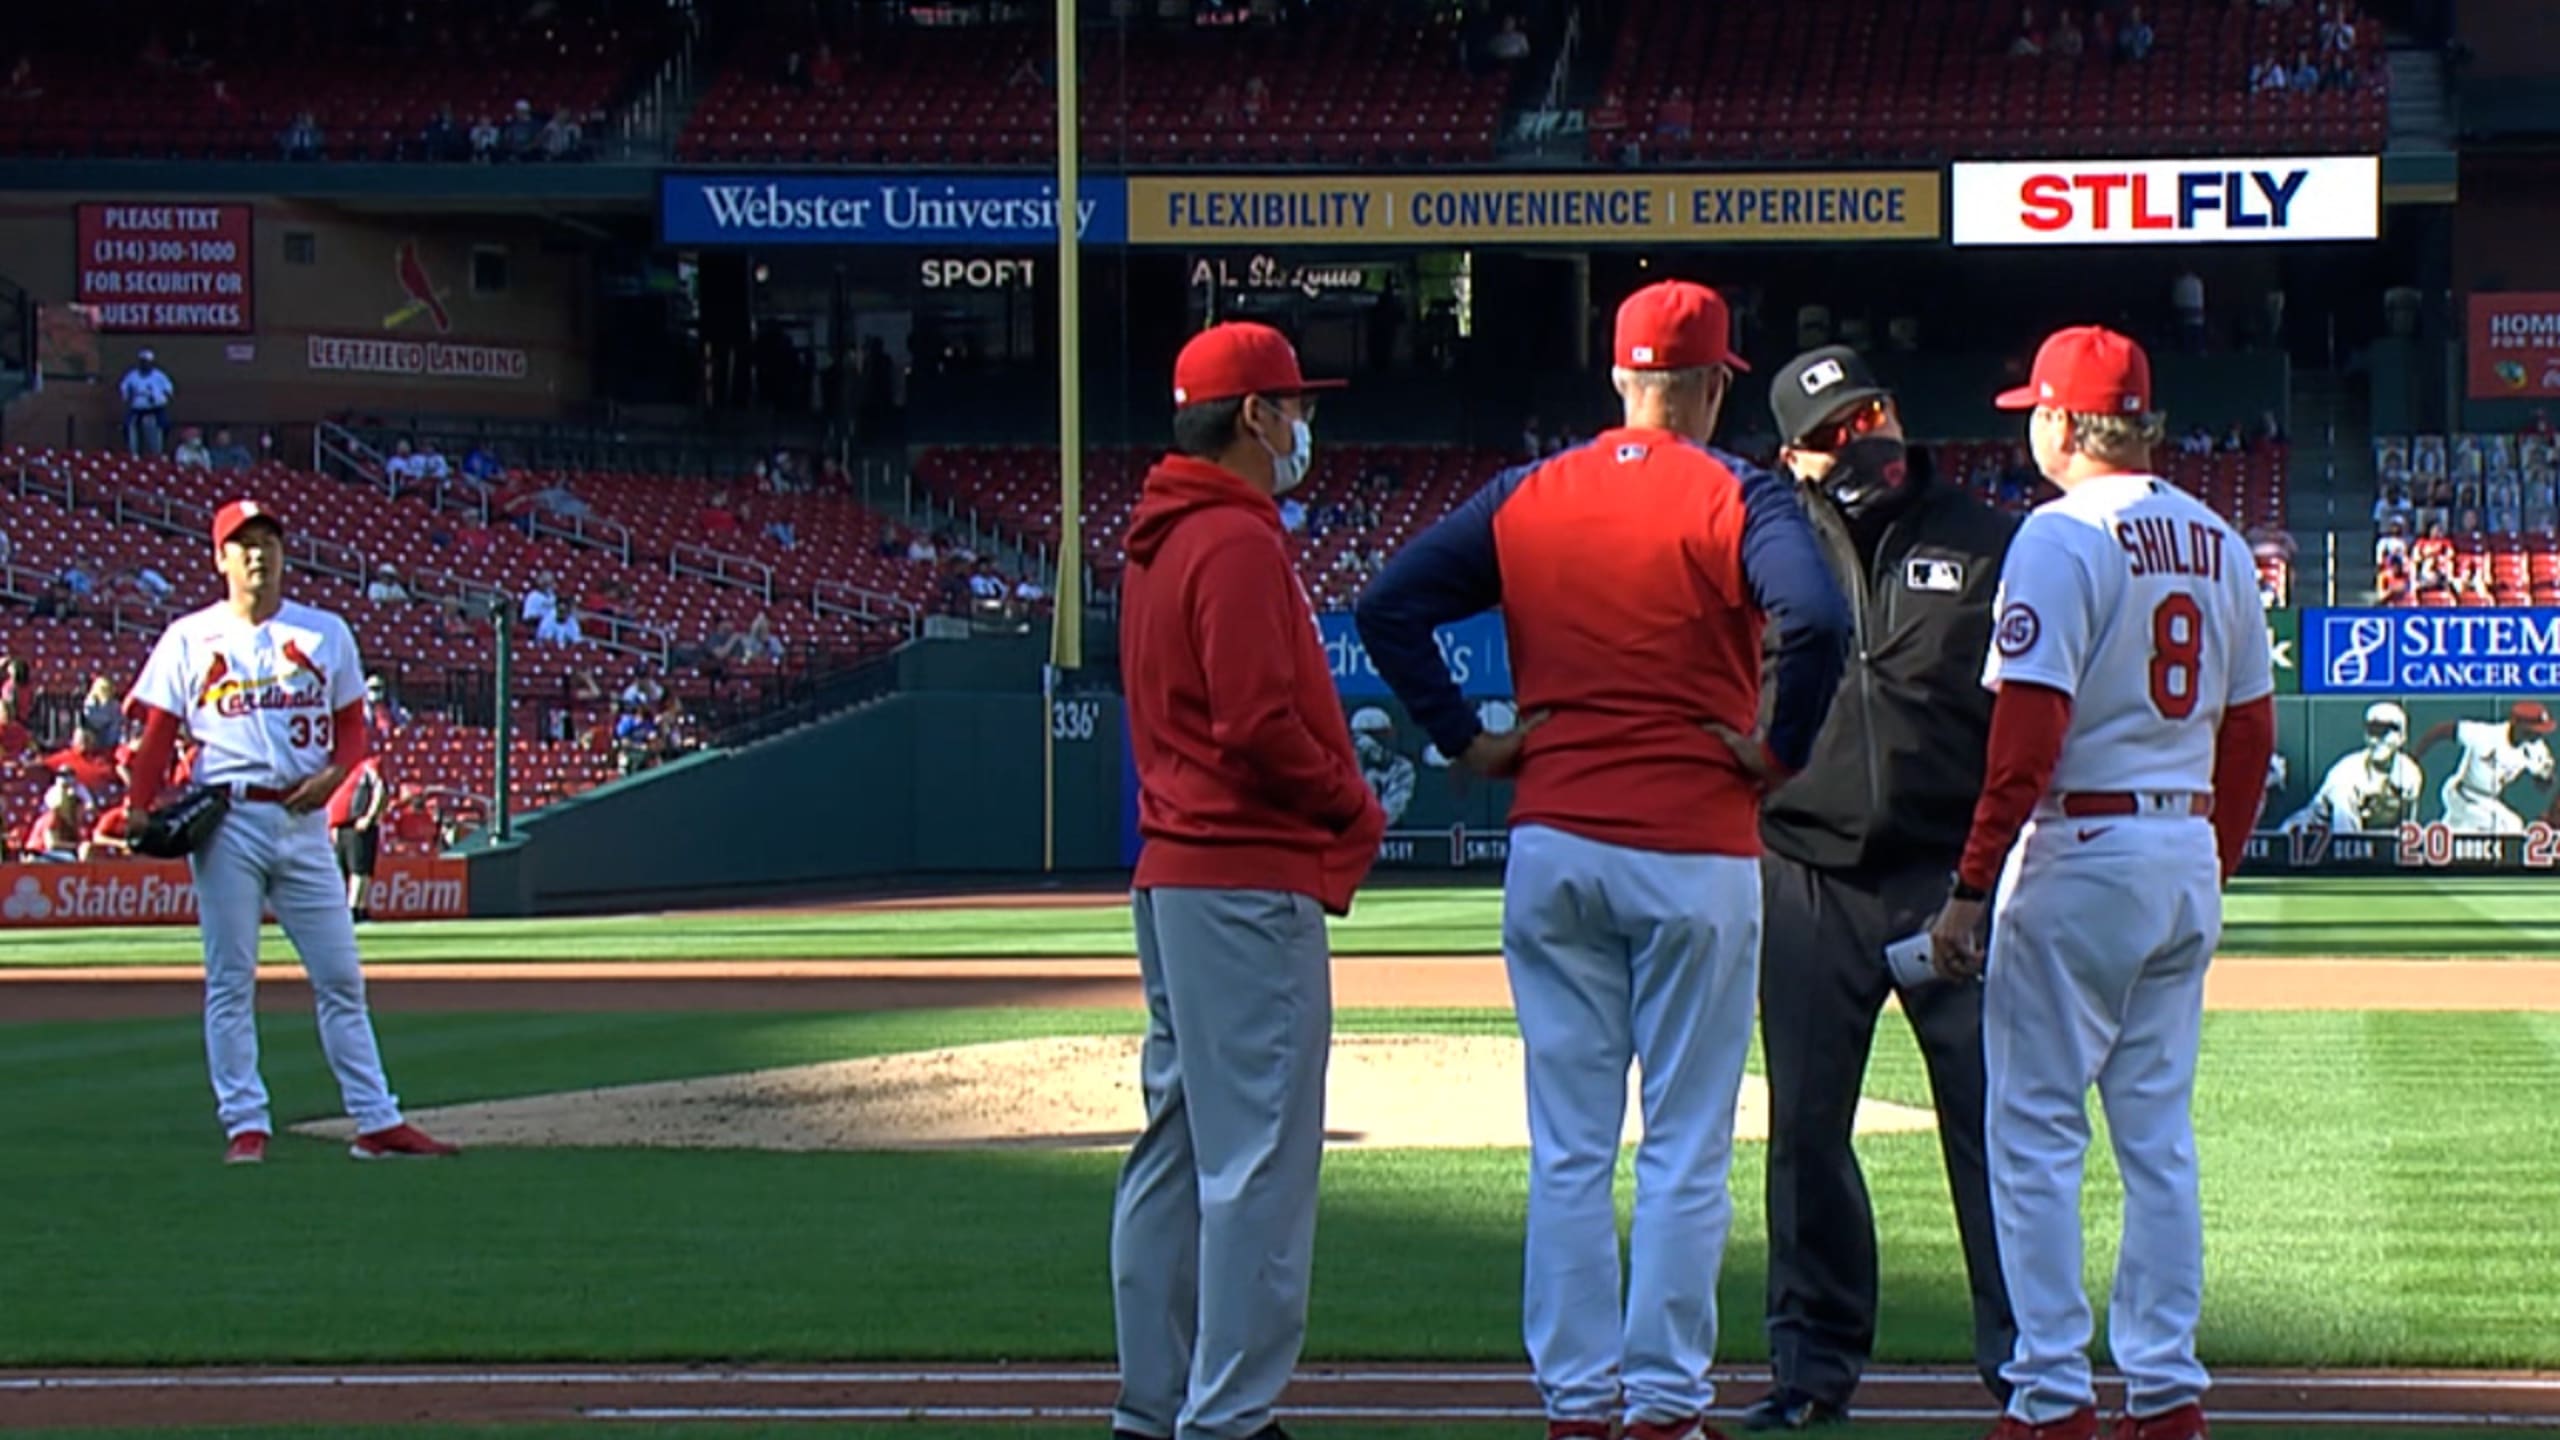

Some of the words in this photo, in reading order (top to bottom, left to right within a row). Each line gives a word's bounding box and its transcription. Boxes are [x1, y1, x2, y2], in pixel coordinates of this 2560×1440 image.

[106, 207, 172, 230] PLEASE
[176, 207, 220, 230] TEXT
[702, 183, 871, 228] Webster
[882, 184, 1097, 237] Universiy
[1168, 191, 1371, 227] FLEXIBILITY
[1411, 190, 1652, 227] CONVENIENCE
[1692, 187, 1905, 224] EXPERIENCE
[2019, 169, 2309, 232] STLFLY
[95, 239, 145, 264] (314)
[149, 240, 236, 263] 300-1000
[85, 272, 121, 294] FOR
[125, 272, 213, 294] SECURITY
[216, 273, 242, 295] OR
[154, 303, 241, 326] SERVICES
[307, 335, 424, 374] LEFTFIELD
[427, 341, 527, 378] LANDING
[2115, 516, 2226, 583] SHILDT
[2148, 591, 2204, 722] 8
[2401, 661, 2520, 687] CANCER
[217, 679, 325, 718] Cardinals
[289, 714, 330, 749] 33
[1052, 700, 1099, 739] 336'
[2287, 823, 2332, 865] 17
[2395, 820, 2454, 866] 20
[2522, 820, 2560, 868] 2
